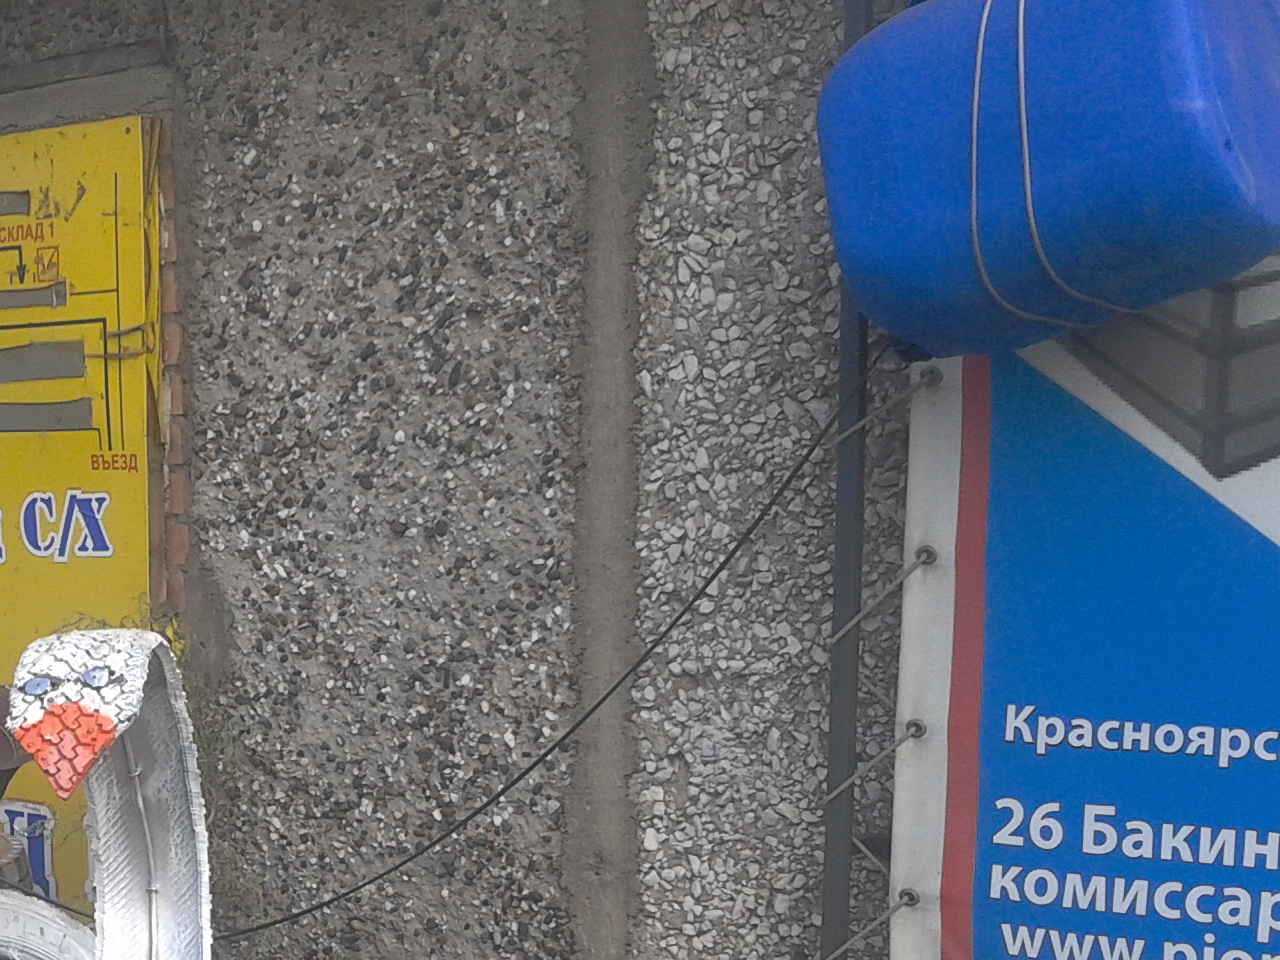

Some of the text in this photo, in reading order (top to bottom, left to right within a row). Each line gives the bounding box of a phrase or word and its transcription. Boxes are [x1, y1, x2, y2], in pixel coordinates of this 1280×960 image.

[48, 220, 55, 238] 1
[91, 453, 139, 474] ВЪЕЗД
[20, 492, 114, 561] С/Х
[992, 797, 1064, 851] 26
